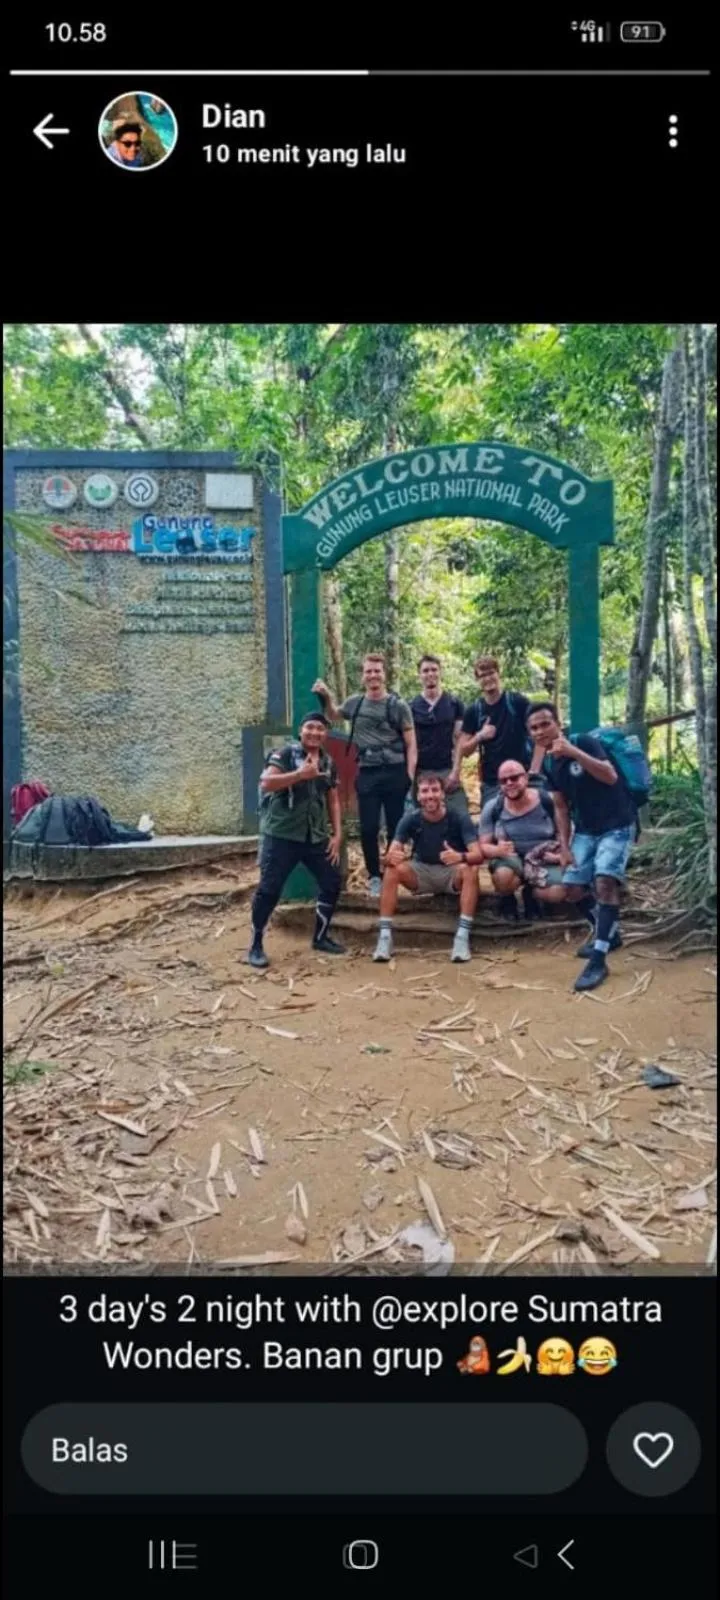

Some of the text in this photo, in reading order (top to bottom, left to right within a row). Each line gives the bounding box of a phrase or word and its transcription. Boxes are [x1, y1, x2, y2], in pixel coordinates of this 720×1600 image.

[302, 447, 587, 530] WELCOME TO
[316, 478, 571, 558] GUNUNG LEUSER NATIONAL PARK
